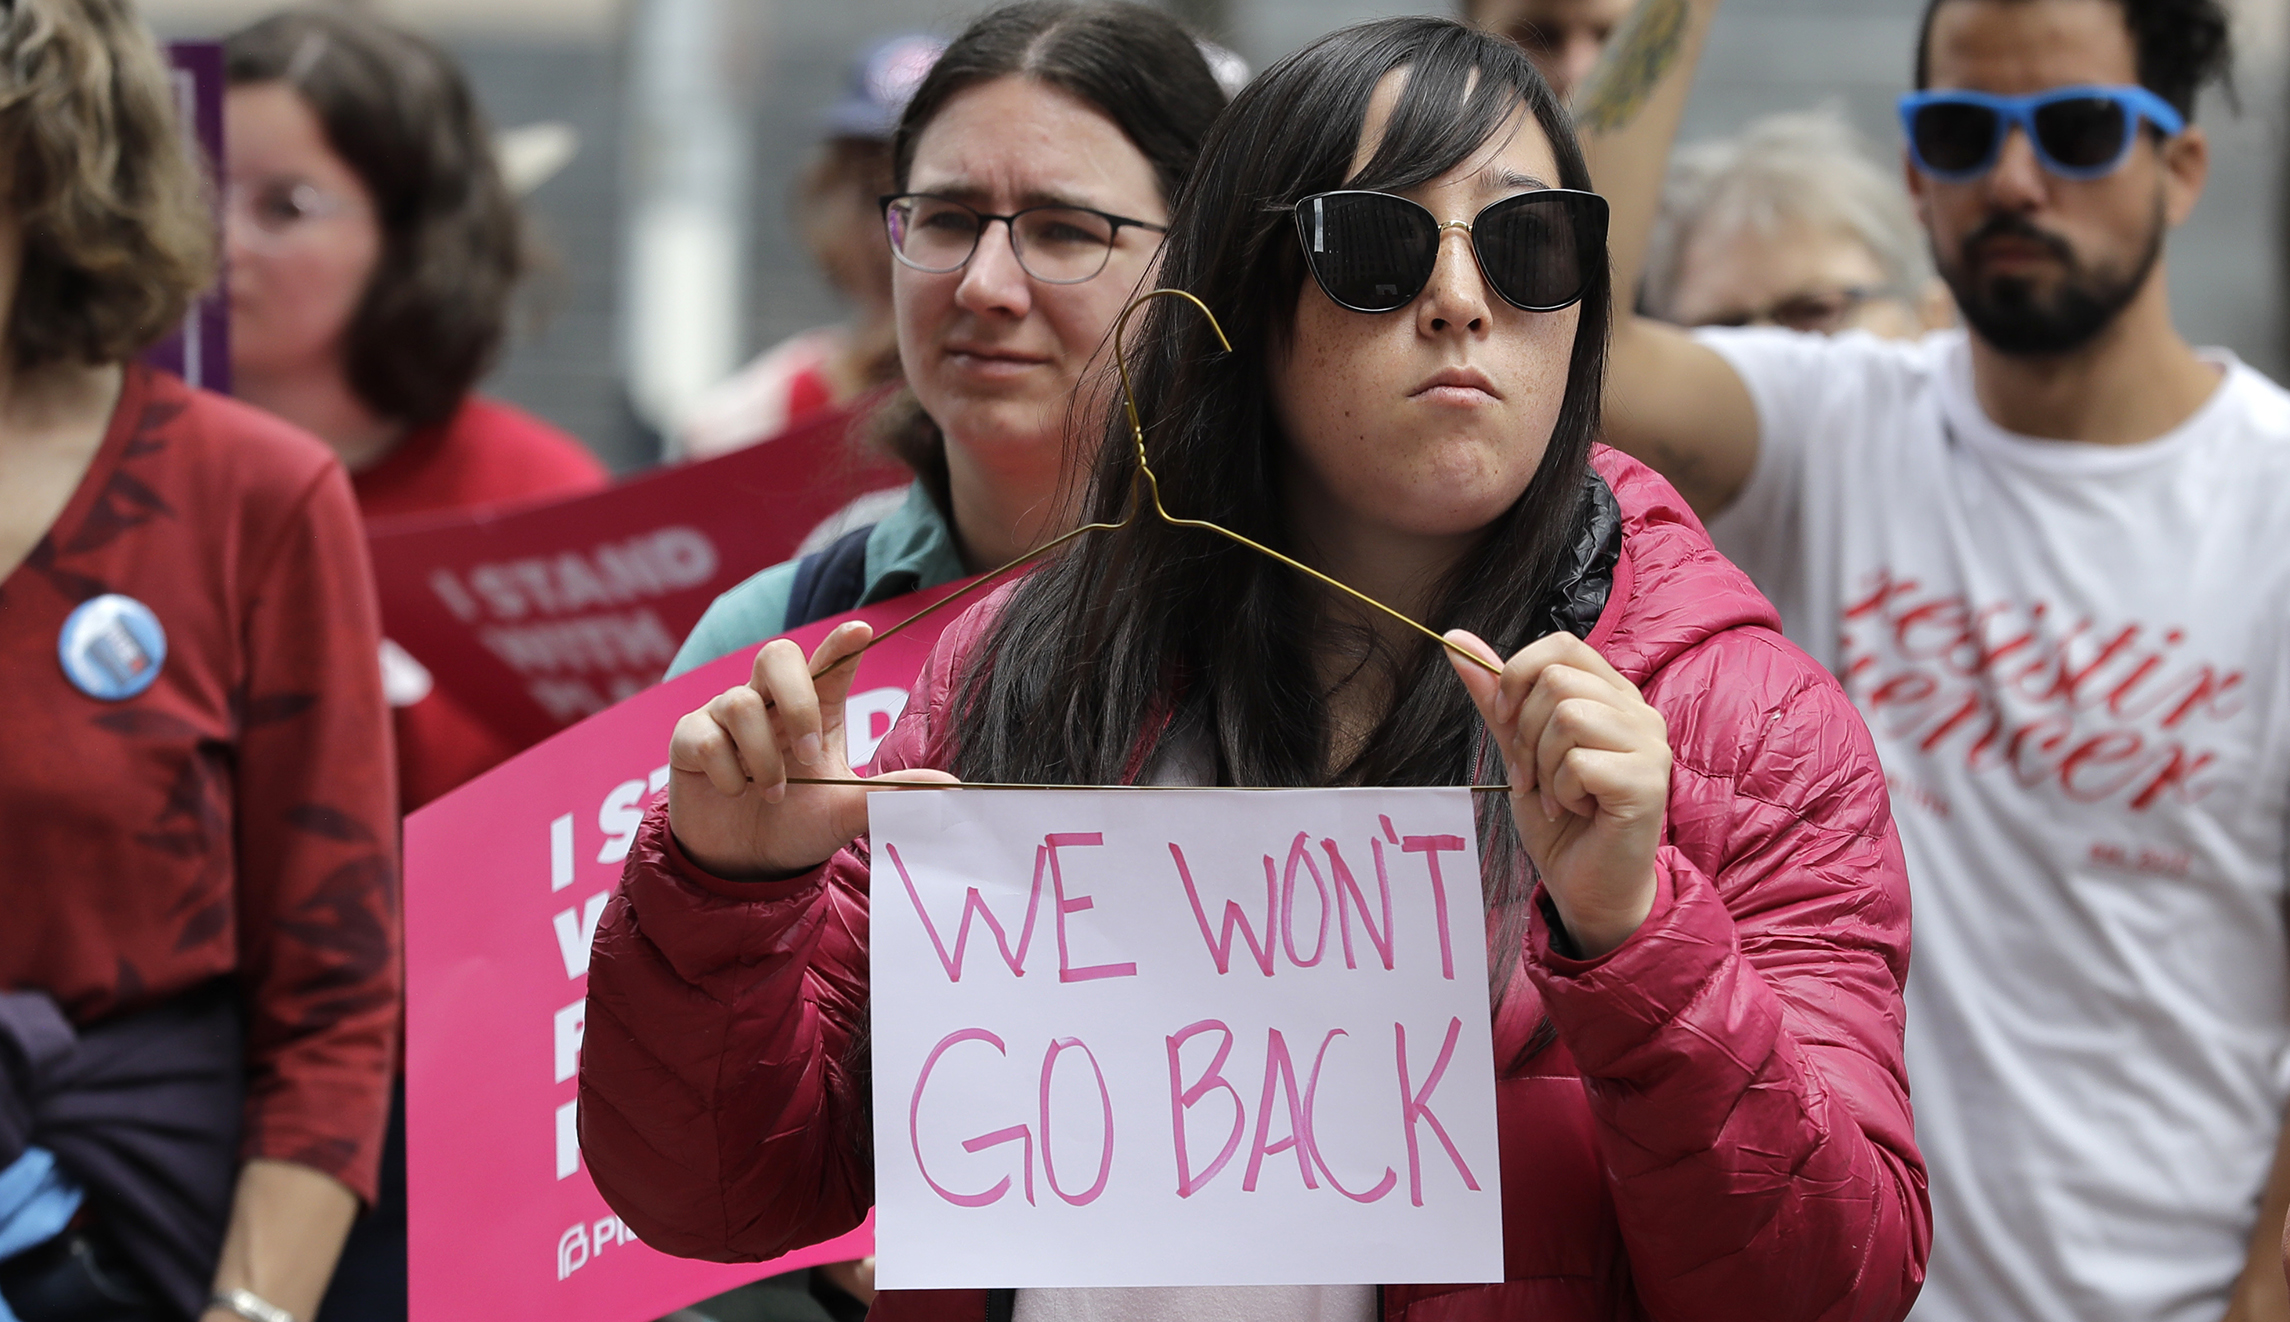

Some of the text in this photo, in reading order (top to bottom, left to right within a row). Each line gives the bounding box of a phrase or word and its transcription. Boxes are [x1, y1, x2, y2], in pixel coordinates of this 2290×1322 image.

[470, 525, 718, 617] STAND
[551, 812, 575, 893] I
[885, 813, 1467, 983] WE WON'T
[909, 1015, 1482, 1208] GO BACK
